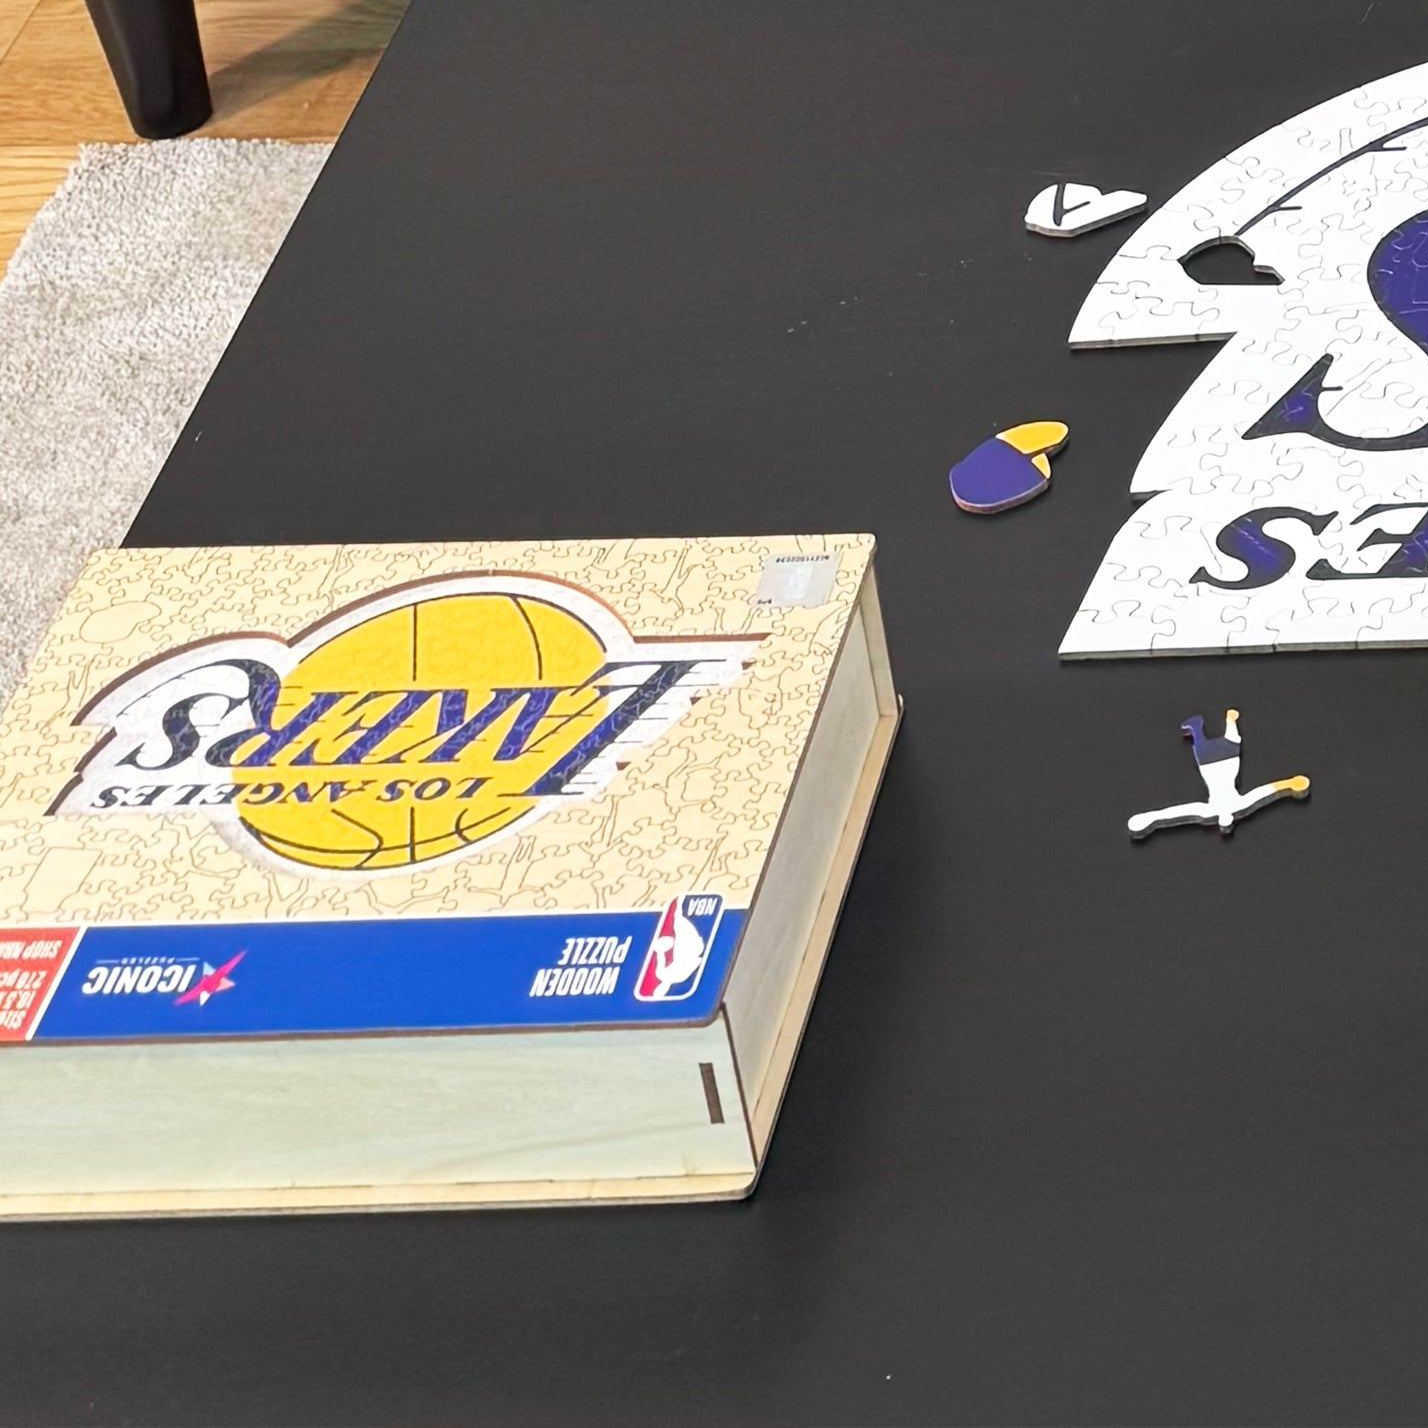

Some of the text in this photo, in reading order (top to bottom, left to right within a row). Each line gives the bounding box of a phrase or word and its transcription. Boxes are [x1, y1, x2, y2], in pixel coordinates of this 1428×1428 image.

[116, 658, 734, 797] LAKERS
[91, 775, 493, 809] LOS ANGELES
[687, 896, 716, 916] NBA
[557, 935, 632, 965] PUZZLE
[82, 964, 197, 994] ICONIC
[529, 966, 620, 997] WOODEN
